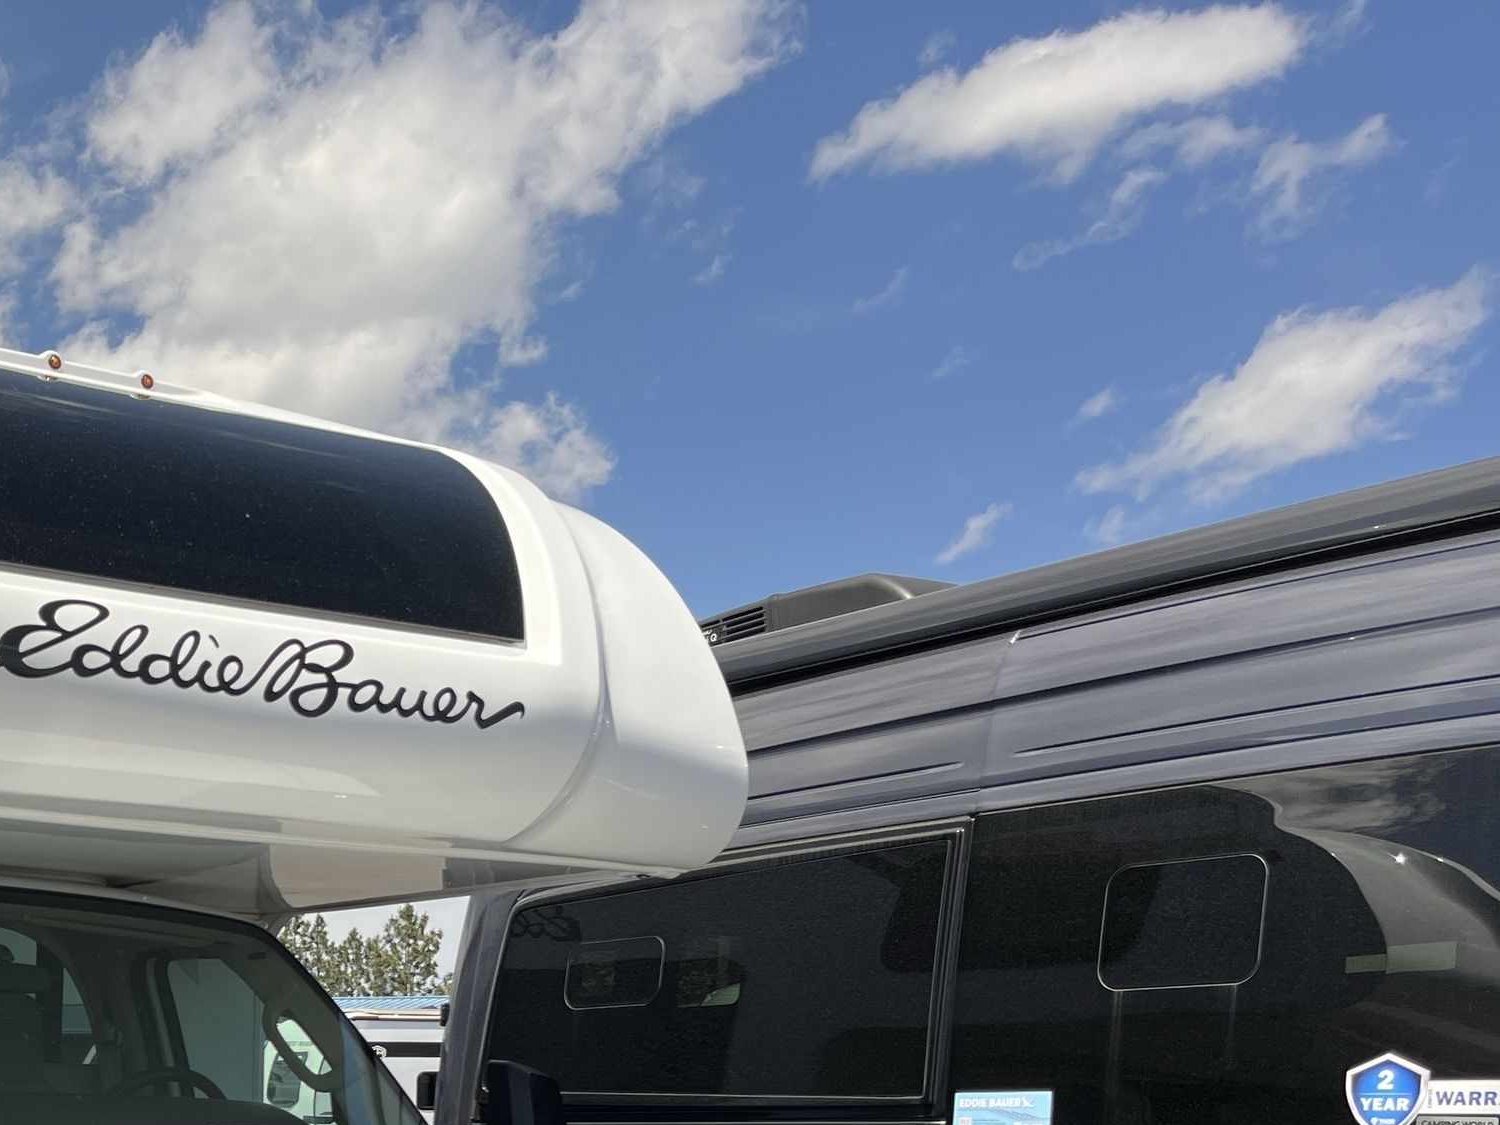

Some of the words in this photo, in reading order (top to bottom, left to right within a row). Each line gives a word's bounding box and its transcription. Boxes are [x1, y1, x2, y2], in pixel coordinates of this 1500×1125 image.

[262, 638, 525, 729] Bauer
[1376, 1068, 1395, 1090] 2
[960, 1098, 987, 1109] EDDIE
[989, 1097, 1021, 1108] BAUER
[1359, 1097, 1409, 1112] YEAR
[1435, 1090, 1500, 1107] WARR
